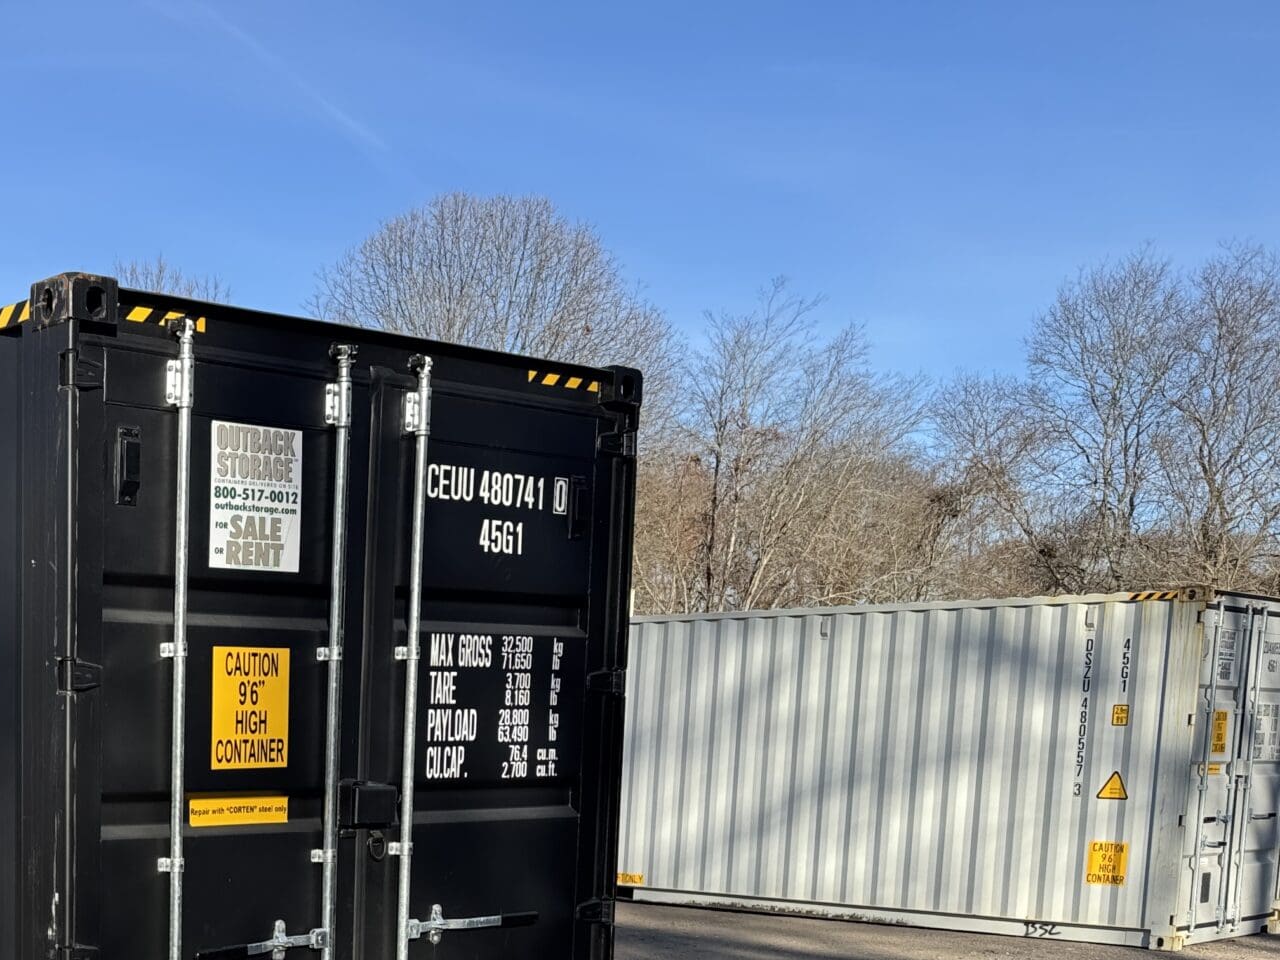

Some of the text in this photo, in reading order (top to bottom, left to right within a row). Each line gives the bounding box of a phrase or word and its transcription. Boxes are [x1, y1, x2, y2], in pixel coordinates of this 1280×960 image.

[216, 423, 296, 457] OUTBACK
[217, 450, 293, 483] STORAGE
[214, 485, 298, 505] 800-517-0012
[427, 463, 567, 513] CEUU 480741 0
[214, 501, 297, 516] outbackstorage.com
[215, 514, 282, 542] FOR SALE
[479, 518, 523, 556] 45G1
[214, 540, 284, 568] OR RENT
[225, 652, 279, 677] CAUTION
[429, 633, 455, 667] MAX
[458, 634, 493, 668] GROSS
[553, 637, 564, 657] kg
[552, 655, 560, 671] lb
[1082, 638, 1094, 693] DSZU
[1121, 637, 1131, 693] 45G1
[429, 671, 458, 705] TARE
[550, 673, 561, 693] kg
[549, 690, 558, 706] lb
[235, 710, 267, 735] HIGH
[427, 709, 477, 742] PAYLOAD
[548, 709, 559, 728] kg
[548, 726, 557, 742] lb
[1076, 697, 1088, 777] 480557
[215, 739, 284, 764] CONTAINER
[508, 744, 528, 761] 76.4
[190, 807, 210, 817] Repair
[211, 807, 225, 815] with
[258, 805, 274, 813] steel
[274, 804, 287, 814] only
